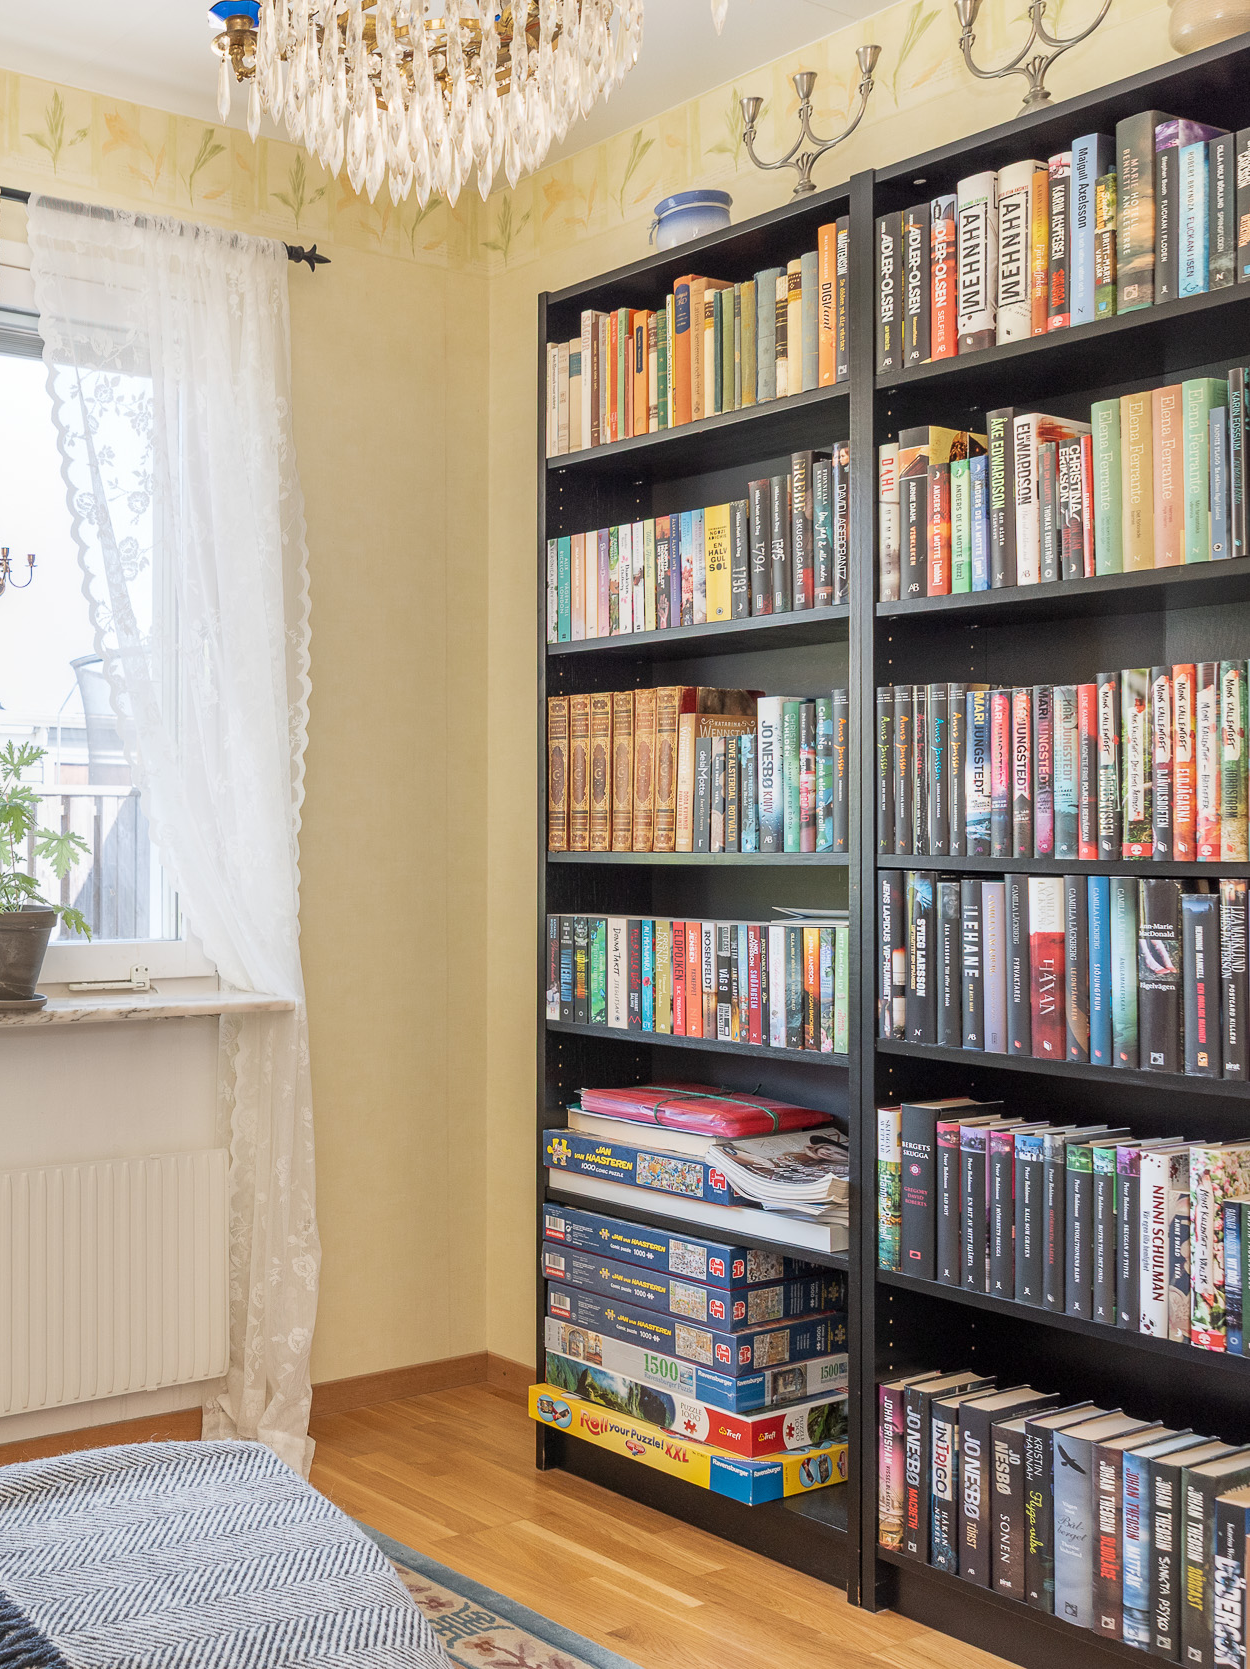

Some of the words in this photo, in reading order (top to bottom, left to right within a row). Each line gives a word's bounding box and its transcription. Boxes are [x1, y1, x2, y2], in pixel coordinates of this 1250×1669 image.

[1076, 147, 1088, 181] Majgull
[1131, 159, 1139, 188] MARIE
[1078, 183, 1089, 229] Axelsson
[1131, 192, 1139, 228] HOTELL
[908, 227, 920, 315] ADLER-OLSEN
[935, 219, 946, 307] ADLER-OLSEN
[1102, 233, 1110, 284] BRITT-MARIE
[881, 234, 893, 322] ADLER-OLSEN
[694, 302, 702, 331] Latinska
[1129, 401, 1143, 441] Elena
[1160, 394, 1175, 436] Elena
[1188, 388, 1204, 430] Elena
[1231, 391, 1240, 416] KARIN
[991, 418, 1008, 439] ÅKE
[1232, 417, 1240, 451] FOSSUM
[991, 441, 1005, 509] EDWARDSON
[1016, 423, 1031, 505] EDWARDSON
[1059, 448, 1069, 502] ERIKSON
[1070, 445, 1081, 512] CHRISTINA
[1130, 444, 1143, 504] Ferrante
[1161, 438, 1175, 500] Ferrante
[1189, 432, 1203, 494] Ferrante
[793, 459, 806, 513] GREBE
[837, 484, 847, 510] DAVID
[956, 514, 962, 522] DE
[956, 524, 962, 533] LA
[795, 519, 803, 585] SKUGGJÄGAREN
[837, 511, 846, 580] LAGERCRANTZ
[709, 564, 727, 572] SOL
[955, 560, 963, 581] [buzz]
[1038, 688, 1047, 720] MARI
[1178, 683, 1186, 701] MONS
[1226, 679, 1234, 698] MONS
[953, 712, 962, 737] Anna
[974, 693, 984, 724] MARI
[1063, 700, 1071, 723] MARI
[1226, 702, 1235, 749] KALLENTOFT
[761, 721, 773, 738] JO
[838, 718, 846, 742] Anna
[1178, 705, 1186, 751] KALLENTOFT
[728, 740, 736, 758] TOVE
[762, 742, 773, 789] NESBØ
[834, 744, 845, 777] Jansson
[950, 742, 961, 775] Jansson
[974, 725, 984, 794] JUNGSTEDT
[1039, 721, 1048, 790] JUNGSTEDT
[1063, 726, 1072, 782] JUNGSTEDT
[728, 760, 736, 800] ALSTERDAL
[1177, 769, 1192, 822] ELDJÄGARNA
[1224, 767, 1238, 818] JORDSTORM
[763, 791, 772, 813] KNIV
[728, 805, 736, 842] ROTVÄLTA
[1012, 912, 1020, 944] LÄCKBERG
[1219, 905, 1231, 930] JAMES
[1230, 905, 1244, 924] LIZA
[916, 919, 925, 948] STIEG
[1231, 924, 1245, 973] MARKLUND
[674, 930, 682, 980] ELDPOJKEN
[1220, 930, 1232, 979] PATTERSON
[561, 950, 571, 1001] VINTERLAND
[719, 969, 729, 982] VÄG
[750, 970, 758, 1008] SNÖÄNGELN
[883, 945, 891, 1001] VIP-RUMMET
[916, 951, 925, 996] LARSSON
[585, 1153, 633, 1170] HAASTEREN
[596, 1146, 612, 1155] JAN
[902, 1141, 930, 1152] BERGETS
[902, 1150, 929, 1159] SKUGGA
[880, 1174, 891, 1208] Hannah
[1152, 1185, 1163, 1224] NINNI
[1199, 1189, 1209, 1210] MONS
[880, 1209, 891, 1239] Richell
[634, 1248, 646, 1258] 1000
[1152, 1228, 1164, 1301] SCHULMAN
[644, 1354, 678, 1381] 1500
[698, 1369, 732, 1386] Ravensburger
[820, 1363, 839, 1378] 1500
[681, 1403, 702, 1416] PUZZLE
[580, 1410, 608, 1435] Roll
[609, 1423, 630, 1439] your
[631, 1431, 664, 1450] Puzzle!
[665, 1440, 689, 1463] XXL
[964, 1431, 980, 1456] JO
[712, 1458, 749, 1477] Ravensburger
[995, 1440, 1011, 1495] NESBØ
[1025, 1434, 1033, 1481] HANNAH
[1034, 1437, 1042, 1476] KRISTIN
[964, 1456, 981, 1520] NESBØ
[1155, 1476, 1172, 1509] JOHAN
[1187, 1486, 1204, 1520] JOHAN
[1026, 1491, 1042, 1526] Flyga
[966, 1521, 977, 1549] TÖRST
[1000, 1514, 1010, 1563] SONEN
[1029, 1527, 1043, 1554] vilse
[1155, 1512, 1172, 1551] THEORIN
[1187, 1521, 1203, 1563] THEORIN
[1159, 1557, 1170, 1594] SANKTA
[1187, 1565, 1204, 1611] RÖRGAST
[1157, 1598, 1170, 1631] PSYKO
